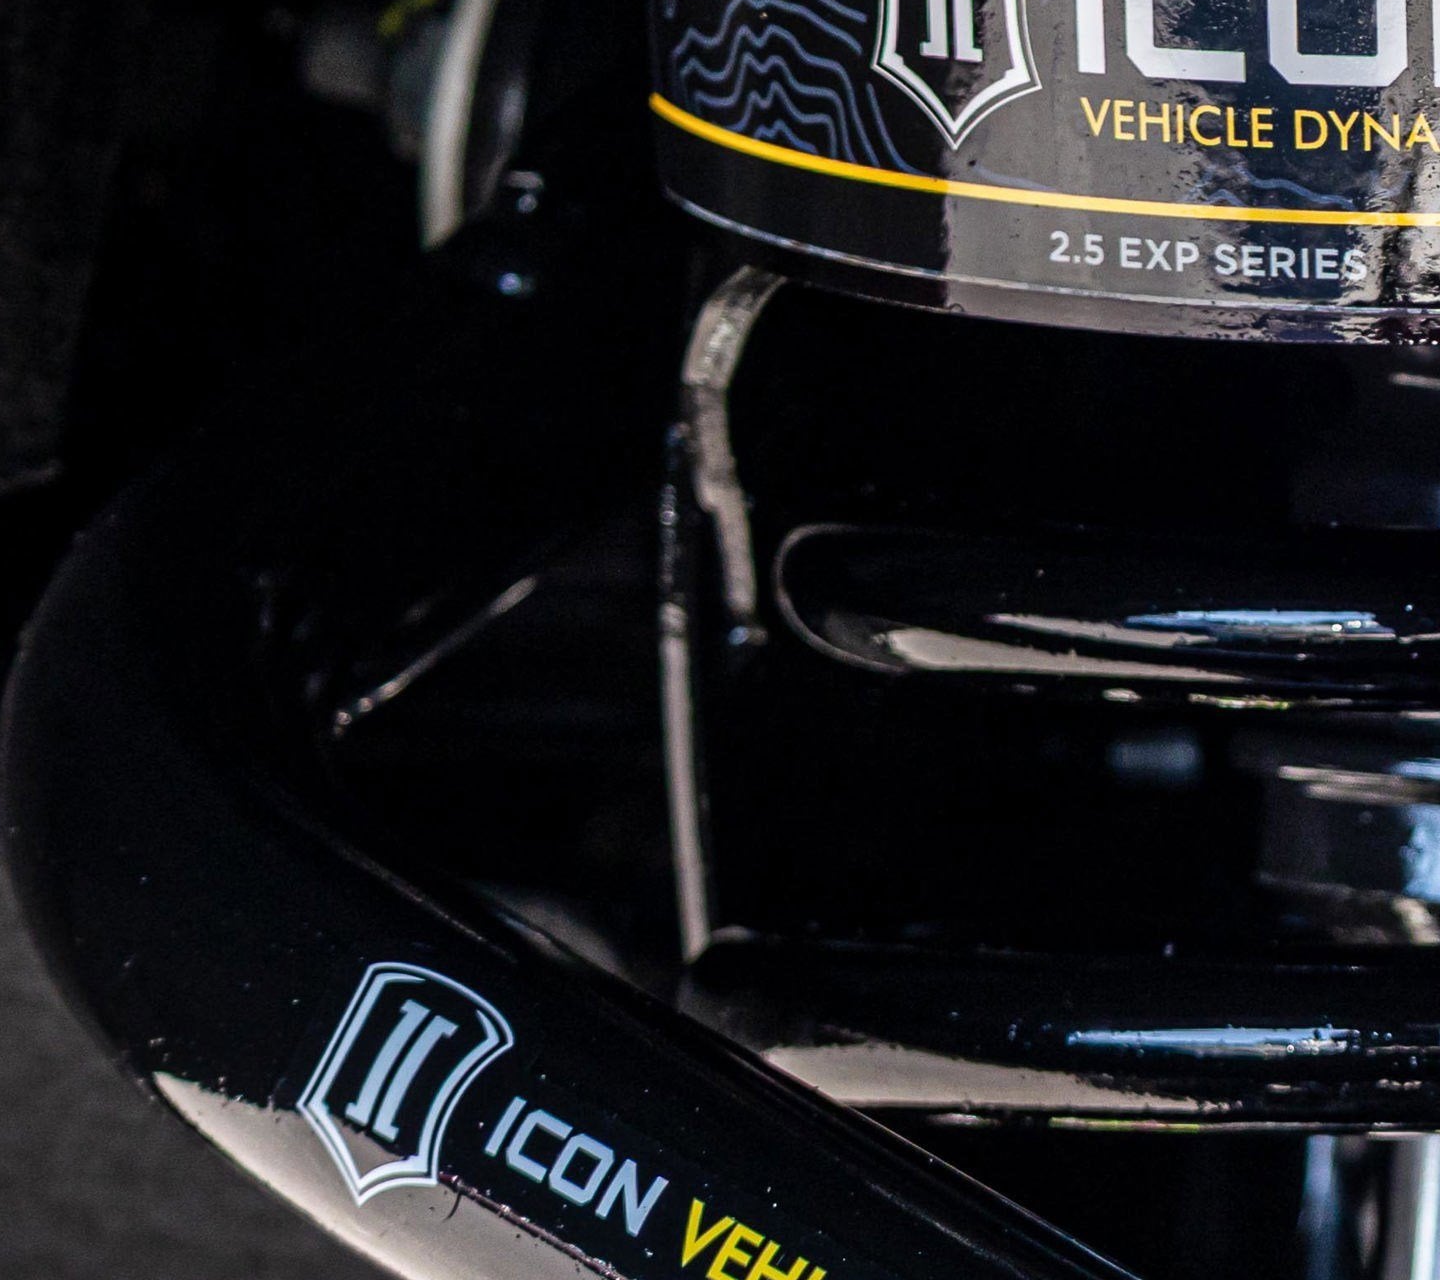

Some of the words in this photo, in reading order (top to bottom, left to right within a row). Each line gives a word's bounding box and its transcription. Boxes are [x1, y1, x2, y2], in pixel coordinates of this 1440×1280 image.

[1080, 96, 1274, 150] VEHICLE
[1048, 230, 1106, 266] 2.5
[1118, 236, 1200, 274] EXP
[1214, 245, 1368, 281] SERIES
[484, 1096, 668, 1237] ICON
